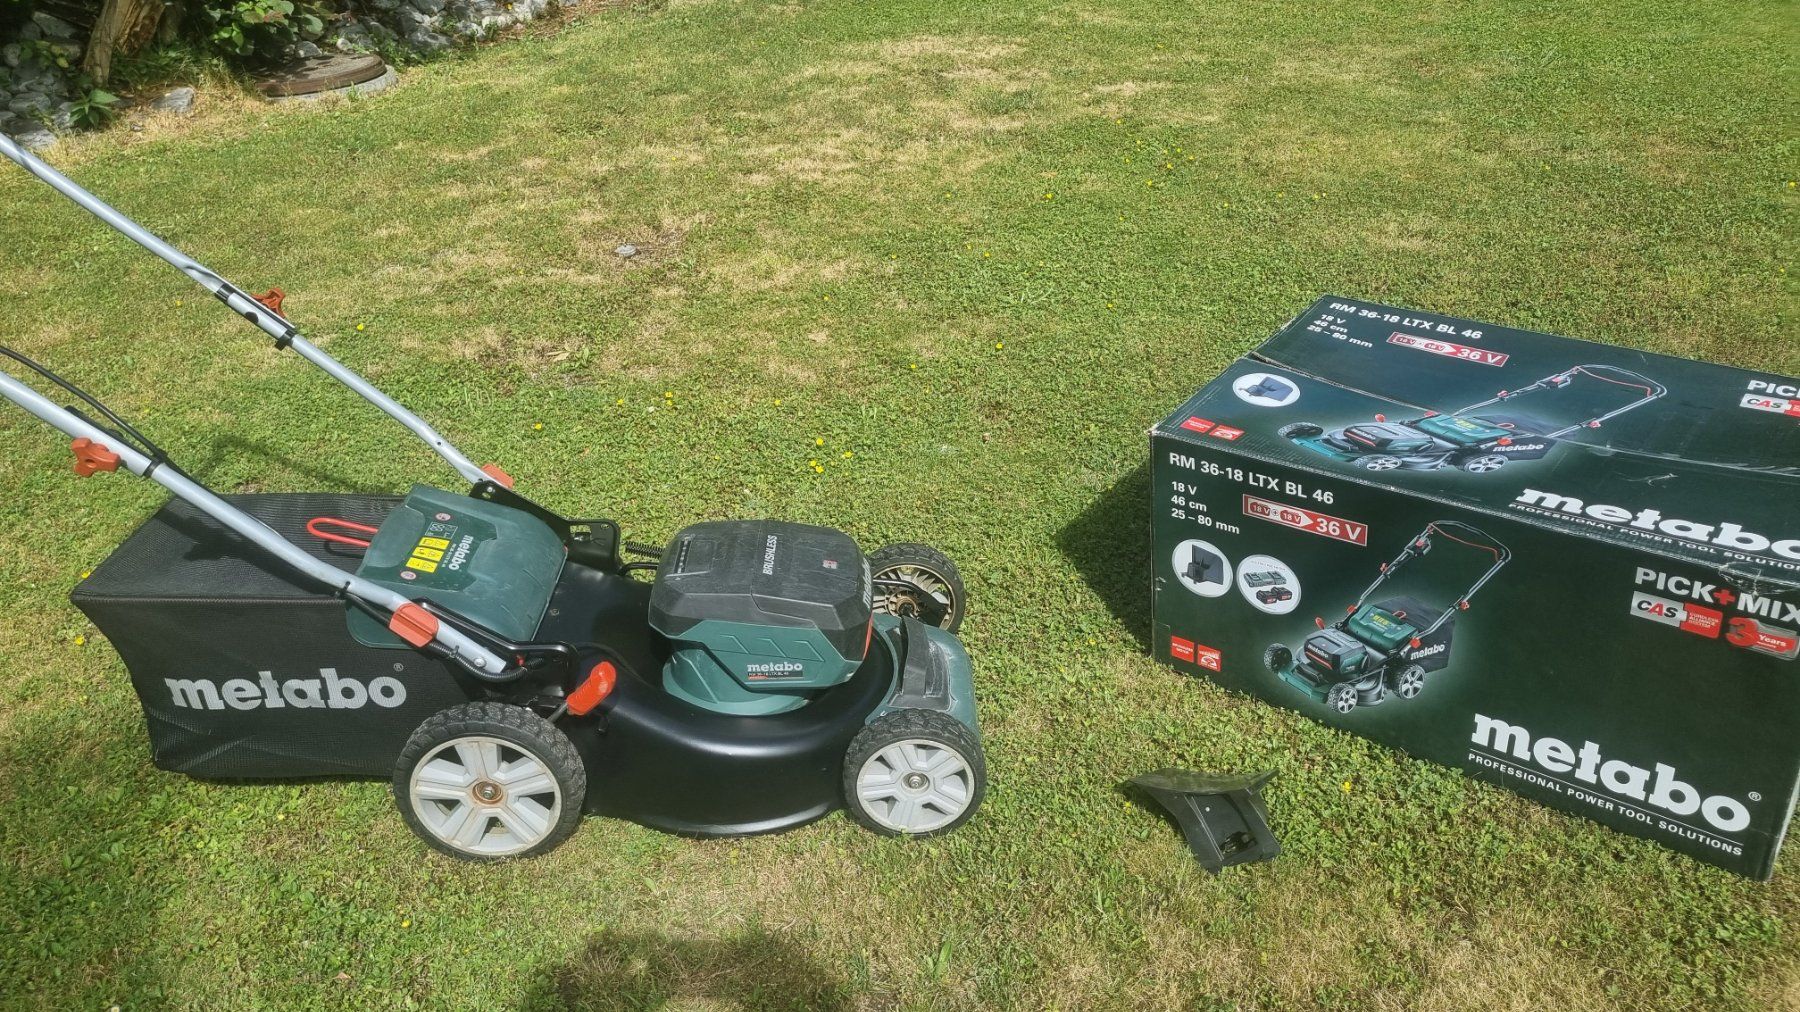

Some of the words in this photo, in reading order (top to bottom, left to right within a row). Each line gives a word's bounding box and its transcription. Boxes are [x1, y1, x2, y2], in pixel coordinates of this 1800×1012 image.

[1329, 302, 1357, 313] RM
[1358, 309, 1400, 323] 36-18
[1402, 317, 1434, 330] LTX
[1436, 323, 1457, 335] BL
[1461, 329, 1483, 339] 46
[1330, 325, 1348, 333] cm
[1348, 337, 1373, 348] mm
[1457, 348, 1482, 360] 36
[1486, 353, 1502, 364] V
[1747, 379, 1800, 398] PIC
[1747, 398, 1783, 409] CAS
[1493, 443, 1545, 452] metabo
[1169, 452, 1196, 470] RM
[1200, 460, 1244, 482] 36-18
[1248, 471, 1280, 492] LTX
[1285, 480, 1308, 499] BL
[1312, 488, 1334, 505] 46
[1171, 481, 1185, 493] 18
[1187, 484, 1197, 495] V
[1170, 494, 1186, 506] 46
[1188, 500, 1207, 512] cm
[1171, 507, 1186, 520] 25
[1197, 514, 1213, 527] 80
[1215, 521, 1240, 535] mm
[1252, 504, 1262, 512] 18
[1283, 512, 1292, 520] 18
[1294, 515, 1301, 523] V
[1315, 517, 1340, 536] 36
[1345, 523, 1362, 540] V
[1508, 503, 1614, 531] PROFESSIONAL
[1619, 527, 1673, 544] POWER
[1679, 541, 1717, 554] TOOL
[449, 534, 474, 570] metabo
[762, 534, 778, 576] BRUSHLESS
[1636, 599, 1679, 619] CAS
[1725, 616, 1758, 649] 3
[1759, 633, 1787, 647] Years
[1411, 643, 1445, 660] metabo
[747, 661, 803, 672] metabo
[164, 667, 407, 711] metabo
[1470, 712, 1751, 833] metabo
[1468, 753, 1563, 793] PROFESSIONAL
[1567, 787, 1614, 811] POWER
[1617, 805, 1653, 825] TOOL
[1658, 820, 1743, 856] SOLUTIONS
